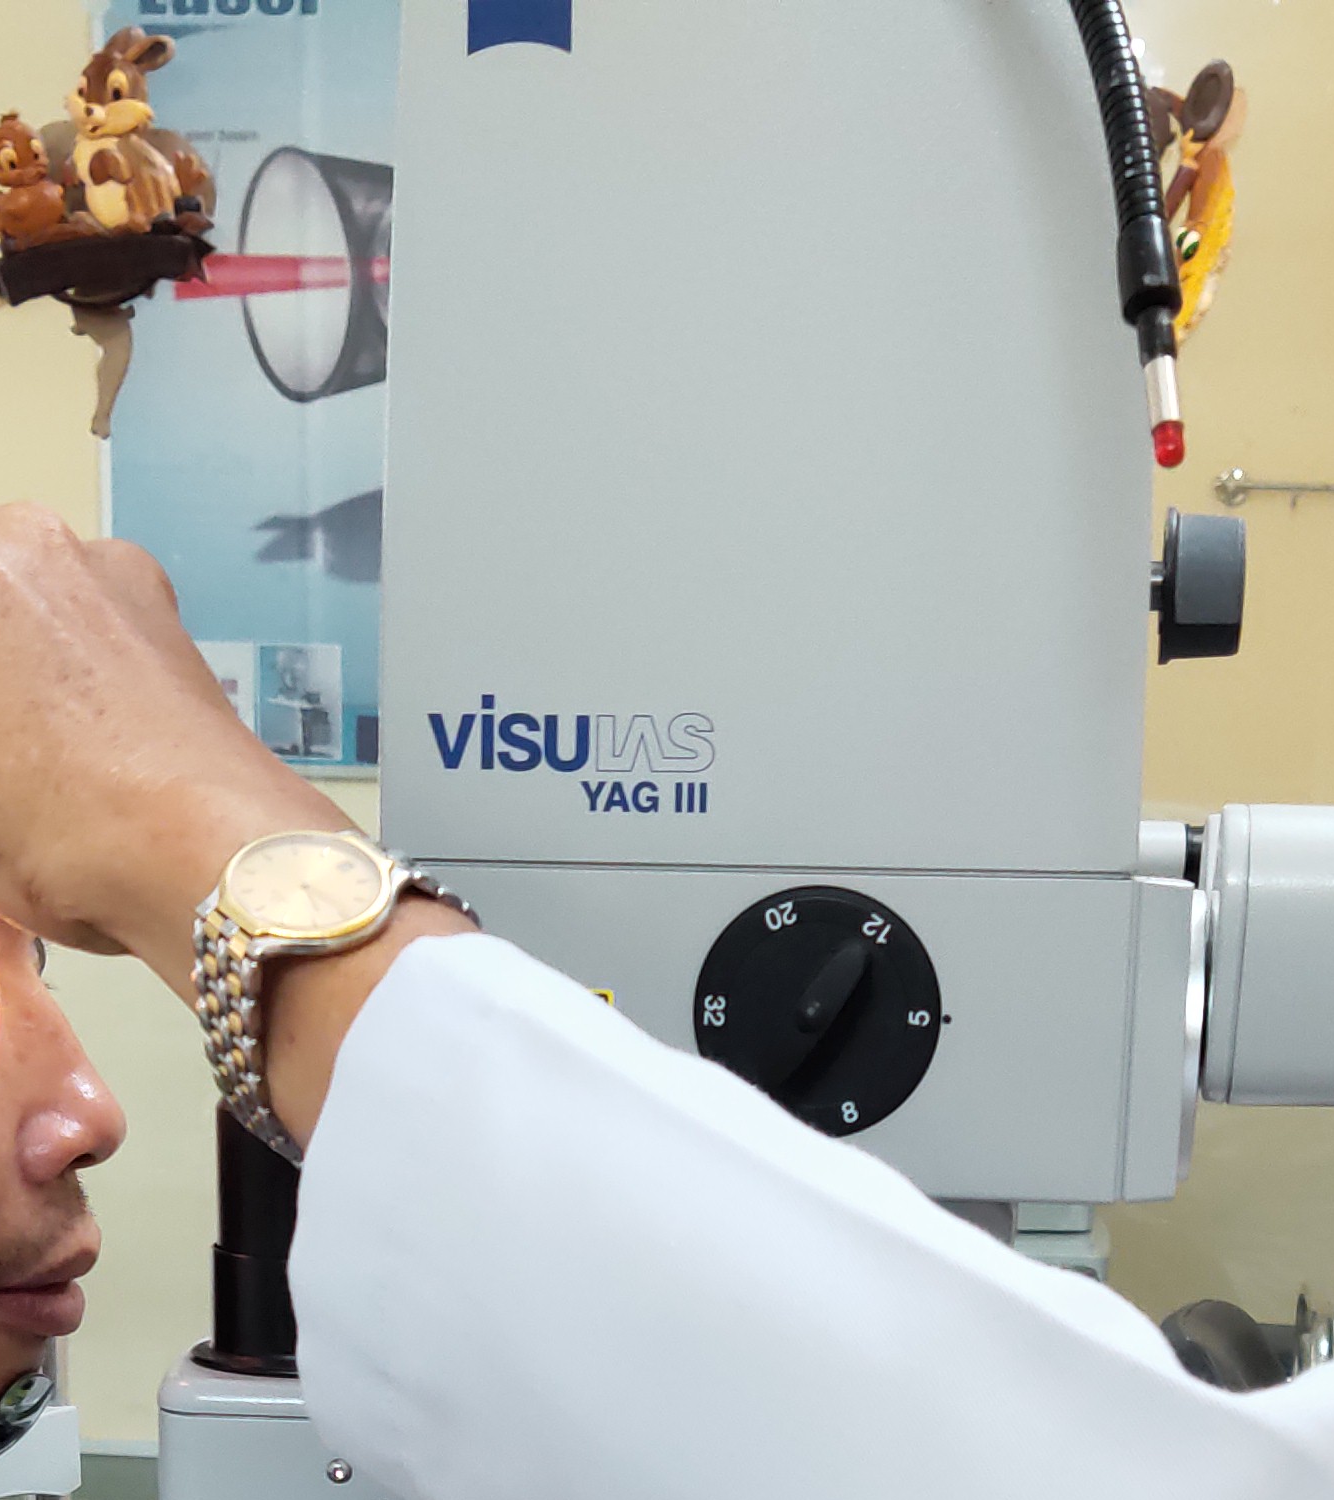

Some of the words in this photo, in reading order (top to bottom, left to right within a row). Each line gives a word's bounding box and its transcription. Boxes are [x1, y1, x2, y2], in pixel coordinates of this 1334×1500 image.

[580, 781, 660, 813] YAG
[674, 782, 708, 813] III
[765, 901, 798, 931] 20
[862, 913, 892, 944] 12
[703, 994, 727, 1027] 32
[907, 1010, 931, 1027] 5
[841, 1101, 859, 1124] 8
